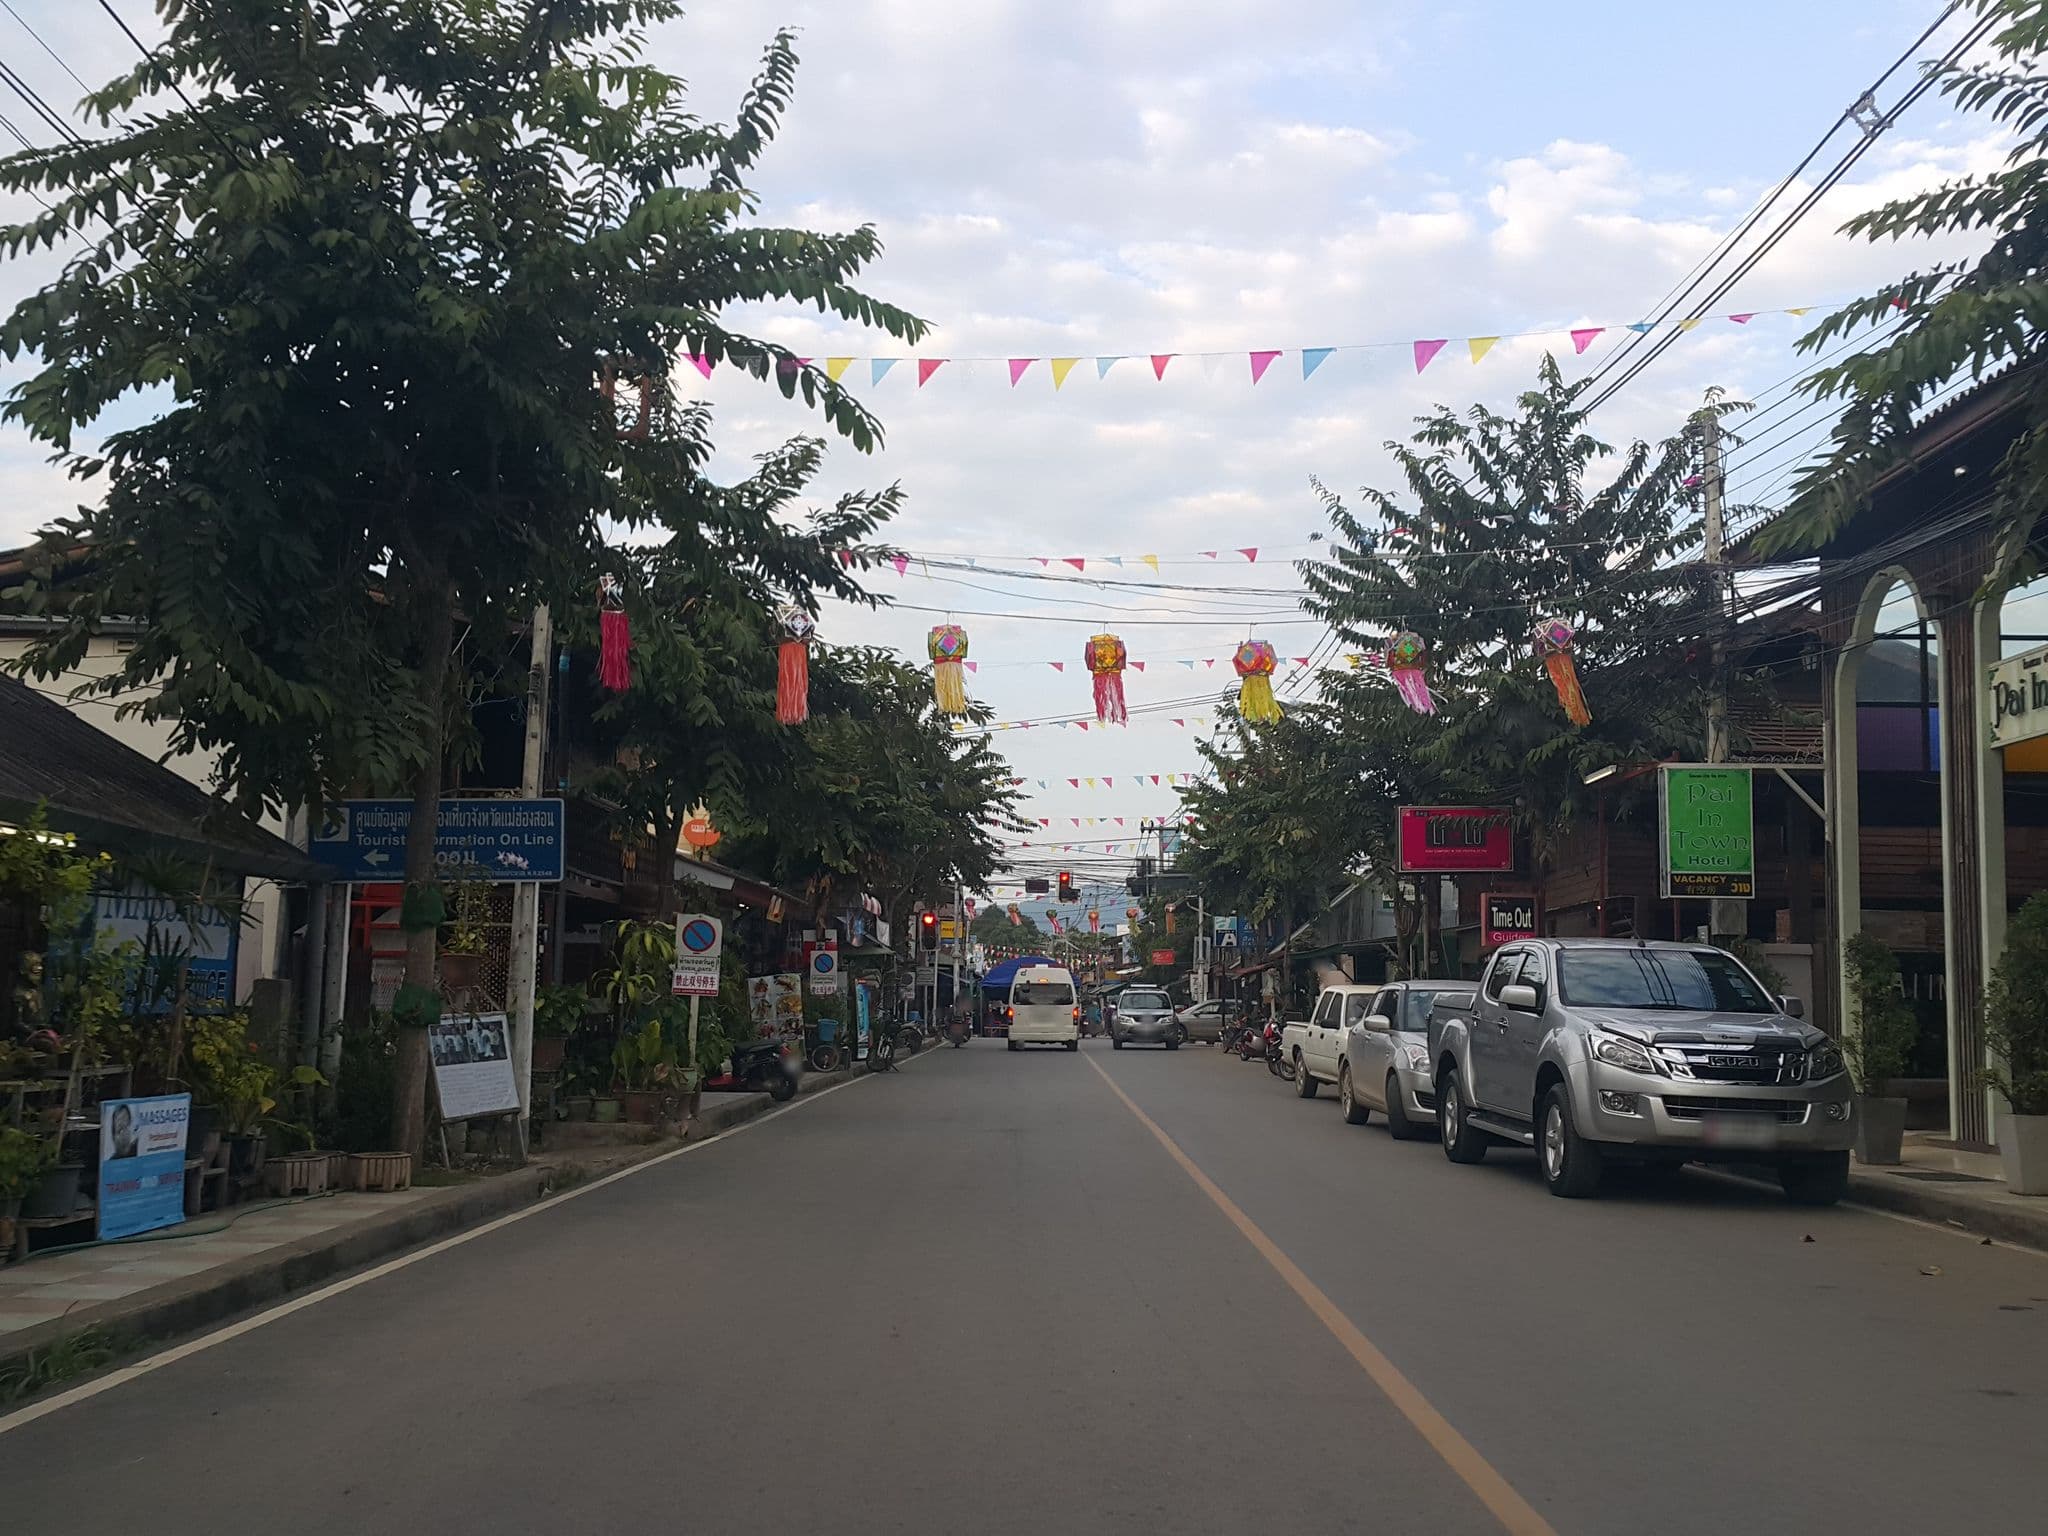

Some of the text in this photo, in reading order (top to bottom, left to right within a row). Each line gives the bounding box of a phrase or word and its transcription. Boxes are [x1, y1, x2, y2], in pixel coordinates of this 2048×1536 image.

[1993, 681, 2026, 729] Pai
[1687, 783, 1734, 805] Pai
[1698, 808, 1723, 828] In
[356, 833, 406, 846] Tourist
[500, 833, 520, 846] On
[524, 833, 554, 845] Line
[1672, 830, 1749, 850] Town
[1688, 855, 1731, 866] Hotel
[1674, 875, 1728, 884] VACANCY
[1491, 906, 1533, 929] Time Out
[1710, 1055, 1760, 1067] ISUZU
